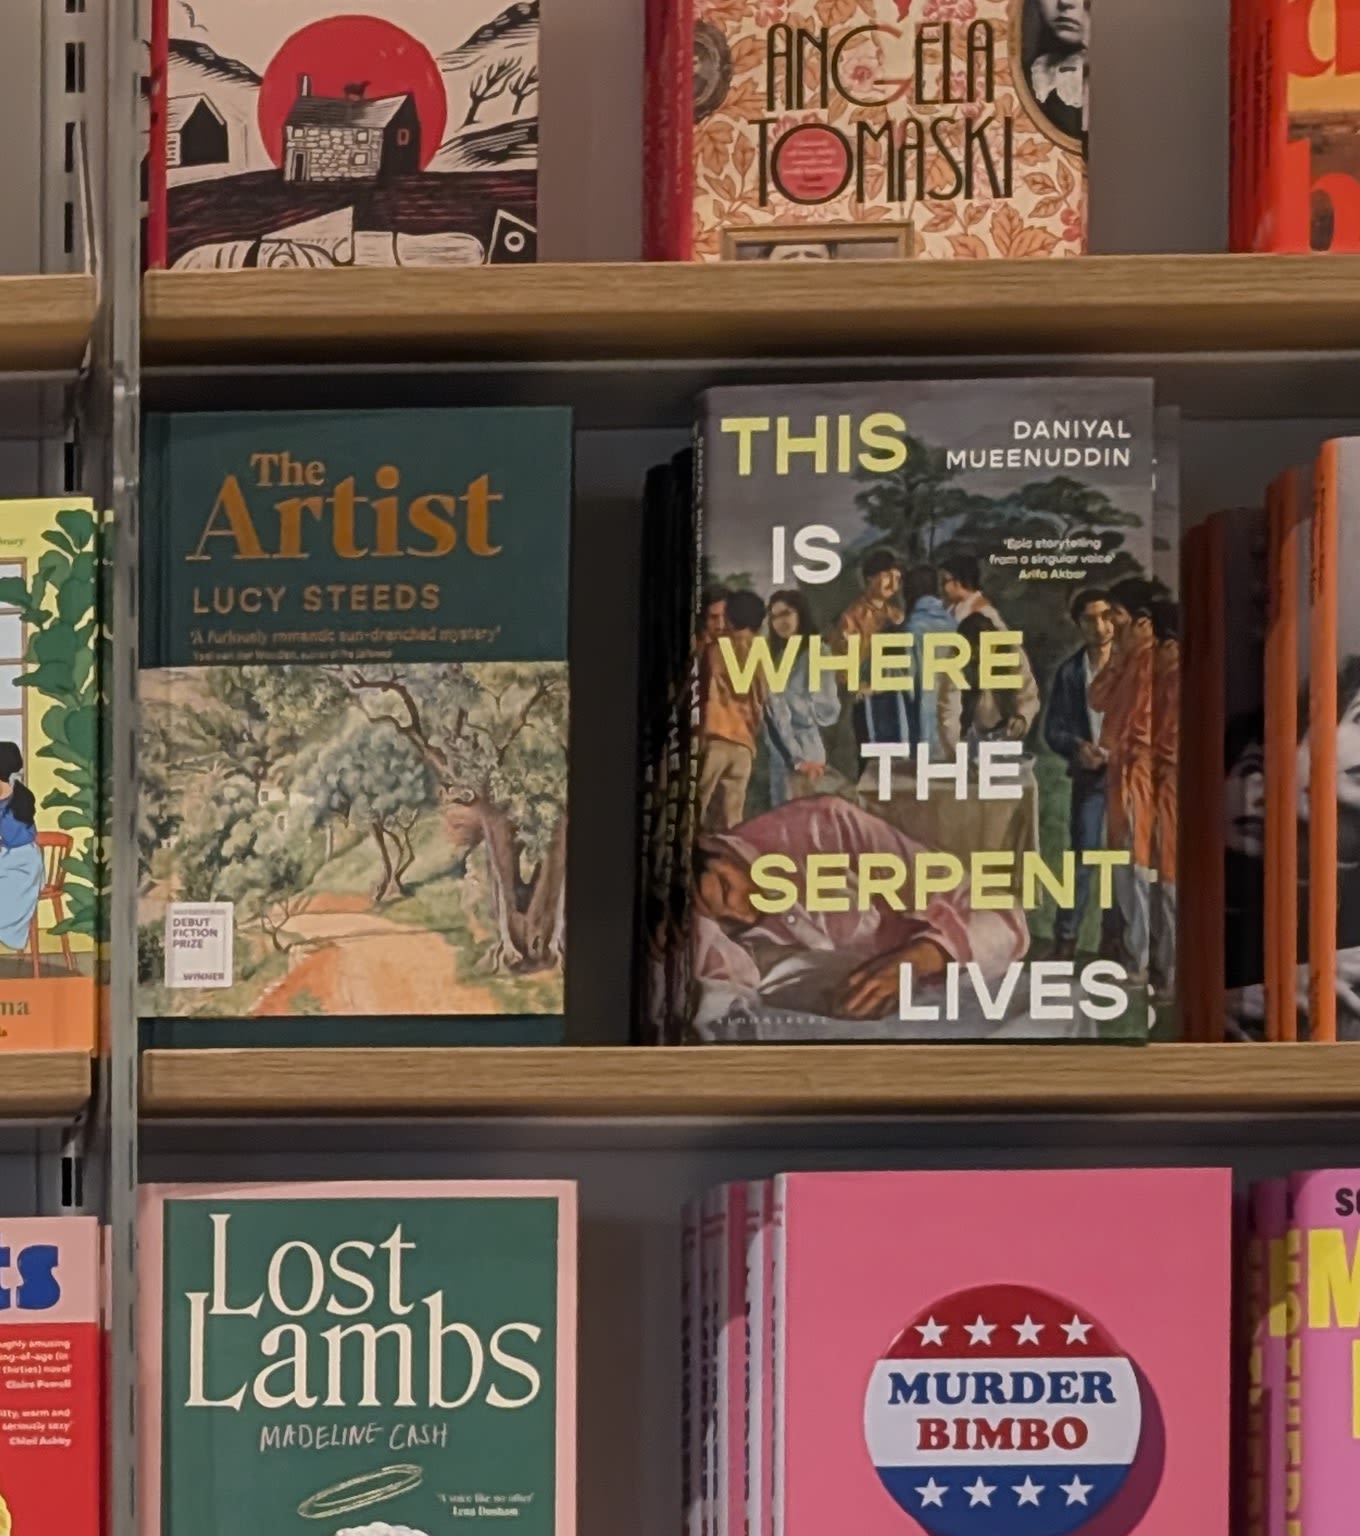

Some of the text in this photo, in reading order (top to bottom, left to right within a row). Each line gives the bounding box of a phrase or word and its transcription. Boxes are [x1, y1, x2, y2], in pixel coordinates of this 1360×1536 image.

[766, 19, 995, 111] ANGELA
[748, 116, 1013, 206] TOMASKI
[720, 413, 908, 476] THIS
[947, 448, 1131, 470] MUEENUDDIN
[1013, 420, 1131, 442] DANIYAL
[251, 451, 324, 486] The
[185, 466, 503, 561] Artist
[771, 524, 842, 584] IS
[193, 584, 439, 613] LUCY STEEDS
[718, 631, 1024, 694] WHERE
[860, 742, 1024, 801] THE
[749, 850, 1130, 913] SERPENT
[173, 917, 209, 927] DEBUT
[173, 928, 218, 938] FICTION
[173, 939, 203, 949] PRIZE
[183, 972, 224, 981] WINNER
[899, 961, 1128, 1021] LIVES
[209, 1214, 416, 1317] Lost
[184, 1290, 542, 1411] Lambs
[887, 1370, 1116, 1405] MURDER
[916, 1417, 1088, 1450] BIMBO
